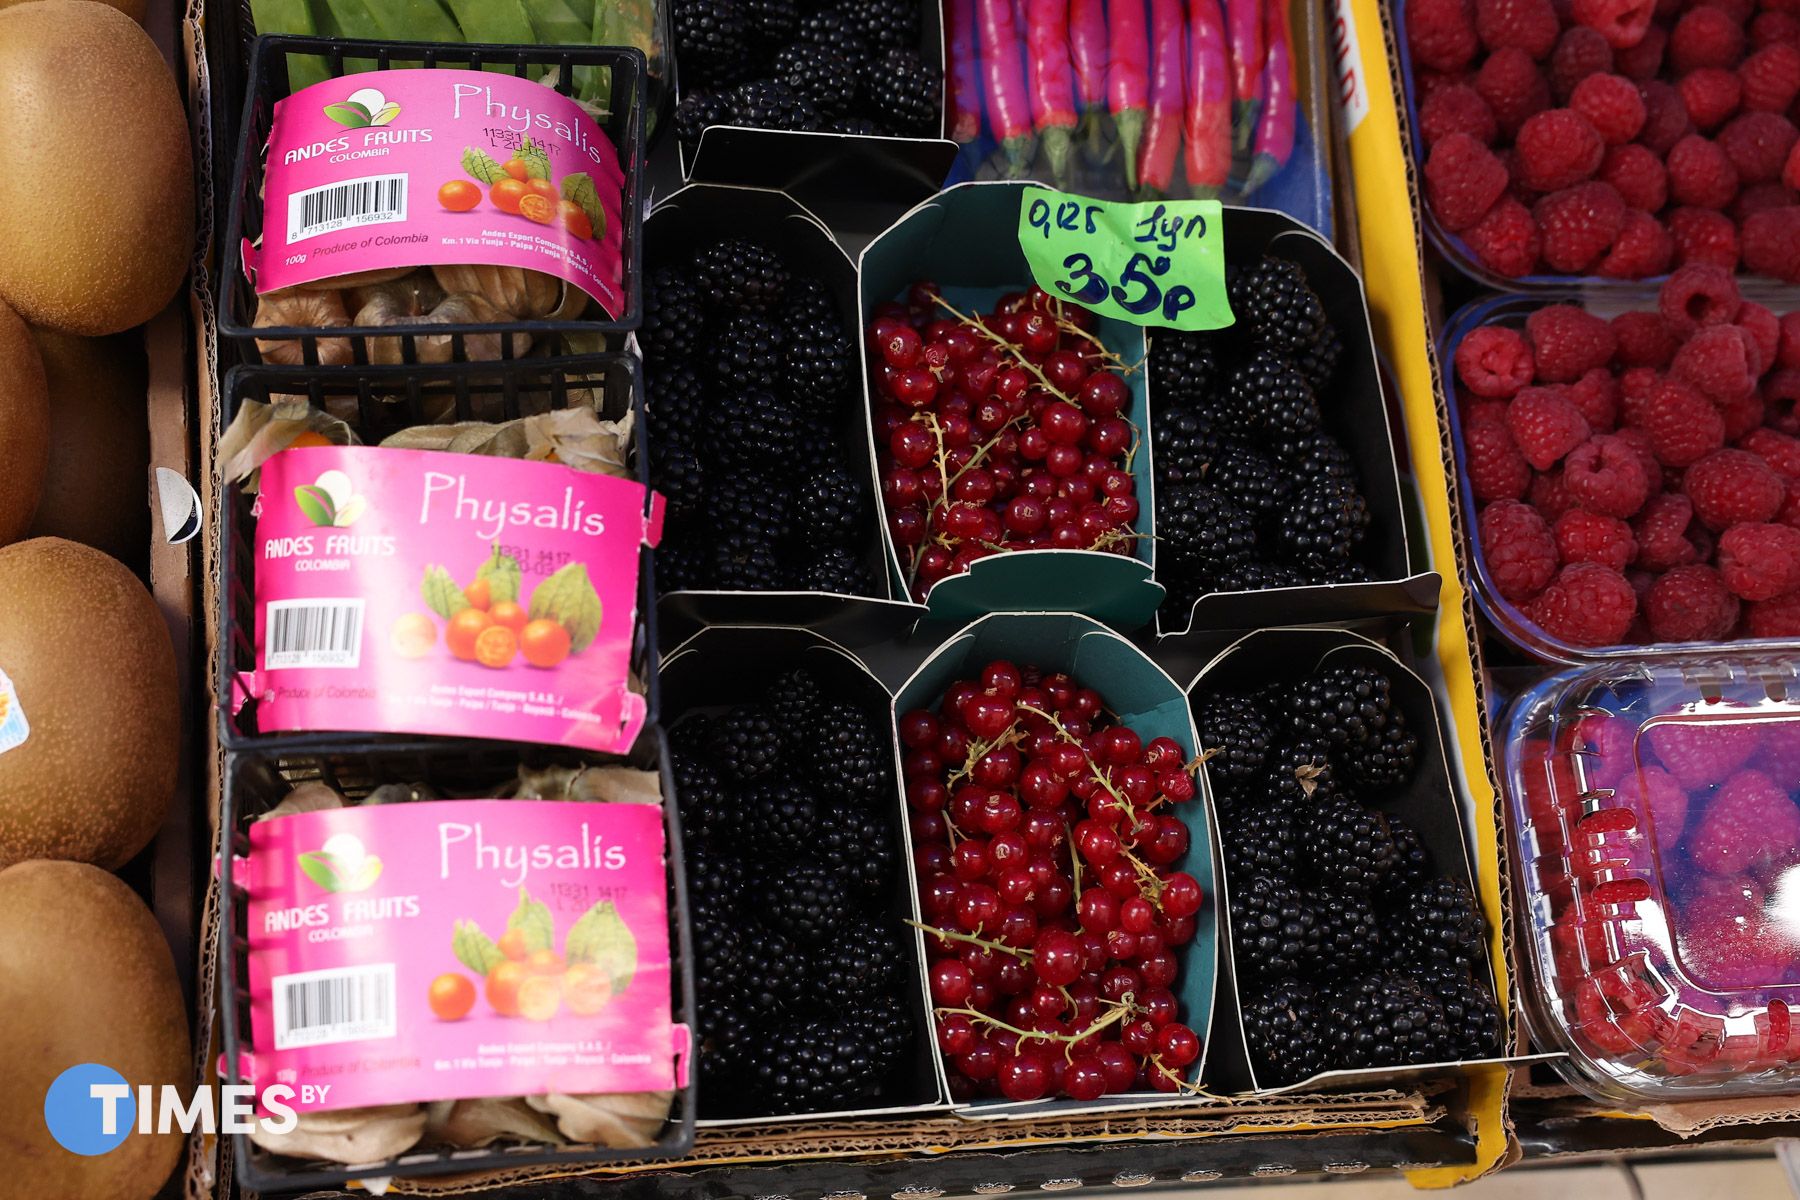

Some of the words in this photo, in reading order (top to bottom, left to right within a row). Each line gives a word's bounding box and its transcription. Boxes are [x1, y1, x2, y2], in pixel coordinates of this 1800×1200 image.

[453, 83, 601, 164] Physalis
[284, 136, 350, 166] ANDES
[364, 128, 433, 147] FRUITS
[329, 147, 390, 164] COLOMBIA
[291, 231, 298, 240] 8
[307, 219, 343, 236] 713128
[356, 211, 393, 224] 156932
[285, 254, 307, 266] 100g
[312, 241, 357, 258] Produce
[360, 237, 373, 248] of
[375, 232, 429, 247] Colombia
[508, 231, 534, 243] Export
[535, 235, 569, 255] Company
[419, 471, 606, 541] Physalis
[265, 535, 315, 560] ANDES
[326, 534, 397, 556] FRUITS
[295, 558, 350, 572] COLOMBIA
[438, 822, 626, 888] Physalis
[264, 903, 329, 934] ANDES
[342, 895, 420, 922] FRUITS
